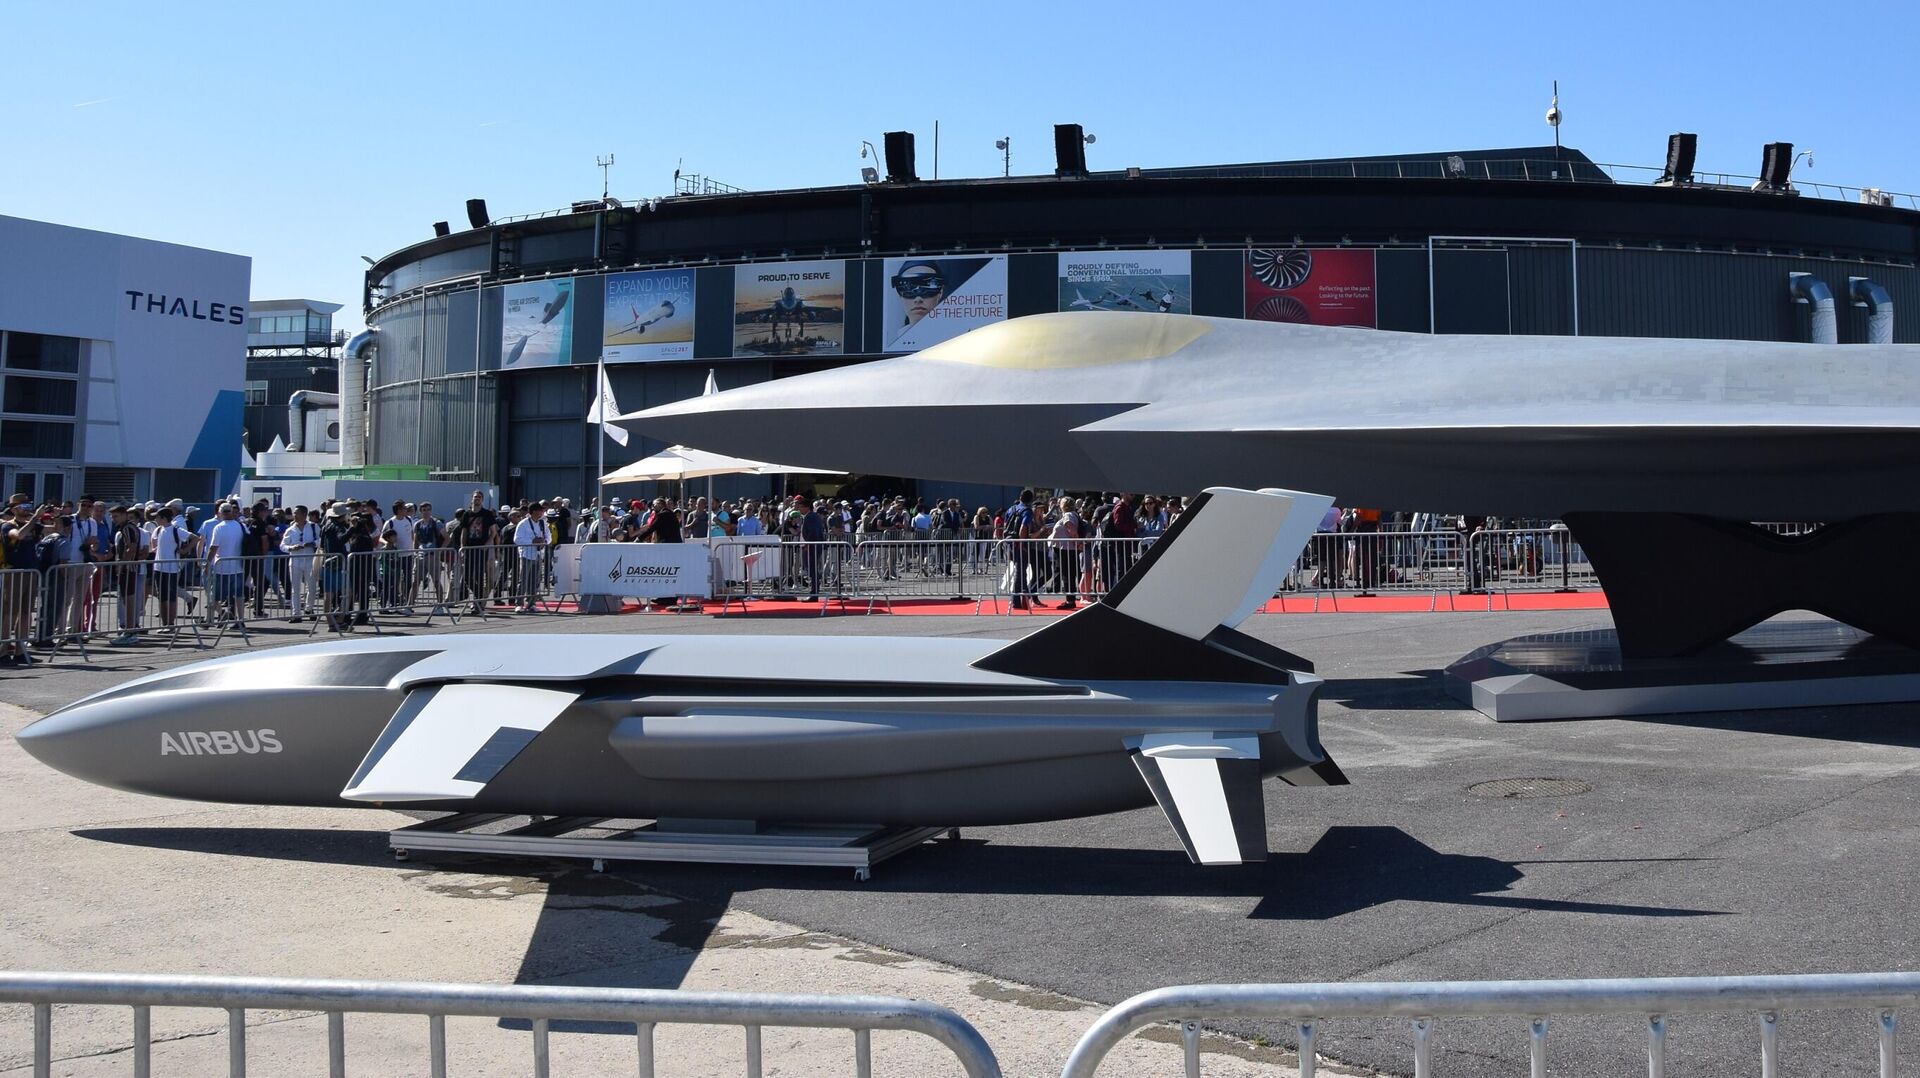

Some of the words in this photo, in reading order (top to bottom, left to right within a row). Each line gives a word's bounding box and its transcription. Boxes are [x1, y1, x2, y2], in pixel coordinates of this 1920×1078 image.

[1067, 263, 1103, 271] PROUDLY
[758, 273, 787, 282] PROUD
[789, 273, 800, 281] TO
[802, 272, 831, 280] SERVE
[609, 278, 653, 295] EXPAND
[656, 275, 689, 291] YOUR
[1319, 285, 1343, 293] Reflecting
[609, 292, 690, 310] EXPECTATIONS
[942, 293, 1003, 306] ARCHITECT
[1319, 292, 1338, 300] Looking
[125, 290, 244, 325] THALES
[928, 308, 941, 319] OF
[943, 307, 962, 319] THE
[963, 306, 1003, 318] FUTURE
[627, 566, 680, 575] DASSAULT
[161, 729, 283, 756] AIRBUS
